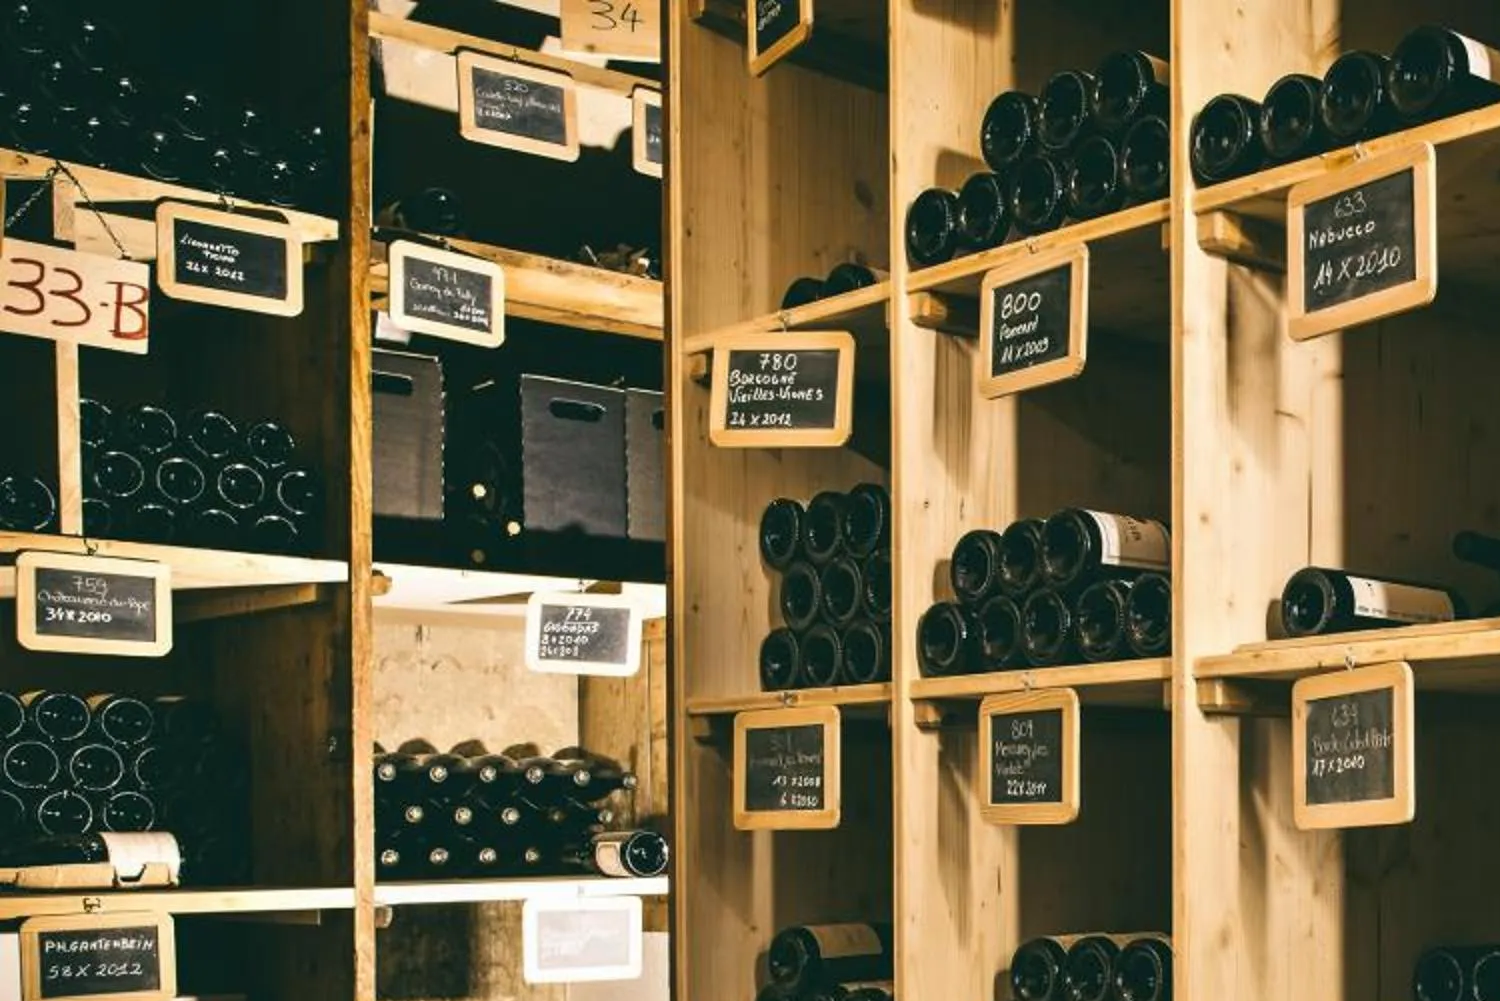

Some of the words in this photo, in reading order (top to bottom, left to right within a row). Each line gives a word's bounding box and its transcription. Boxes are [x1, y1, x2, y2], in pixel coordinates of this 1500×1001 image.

[590, 0, 644, 32] 34
[1334, 191, 1367, 219] 633
[4, 257, 149, 341] 33-B
[1001, 292, 1041, 320] 800
[759, 353, 797, 371] 780
